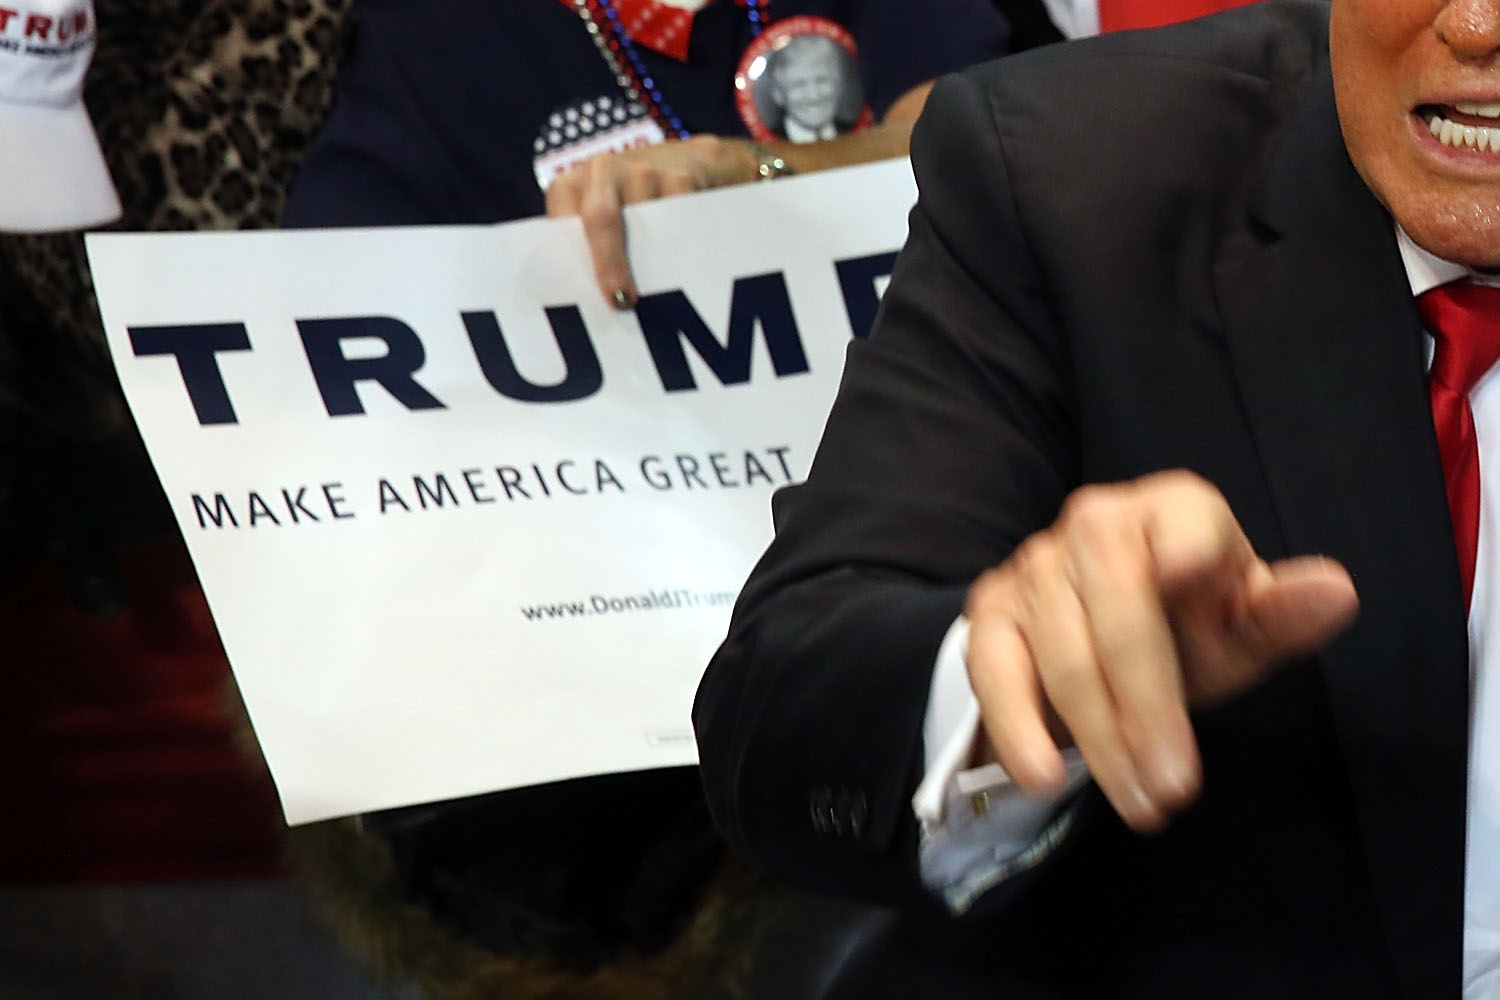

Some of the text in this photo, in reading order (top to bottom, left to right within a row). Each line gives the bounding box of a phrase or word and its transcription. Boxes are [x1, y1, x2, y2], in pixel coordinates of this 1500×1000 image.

[190, 446, 792, 531] MAKE AMERICA GREAT
